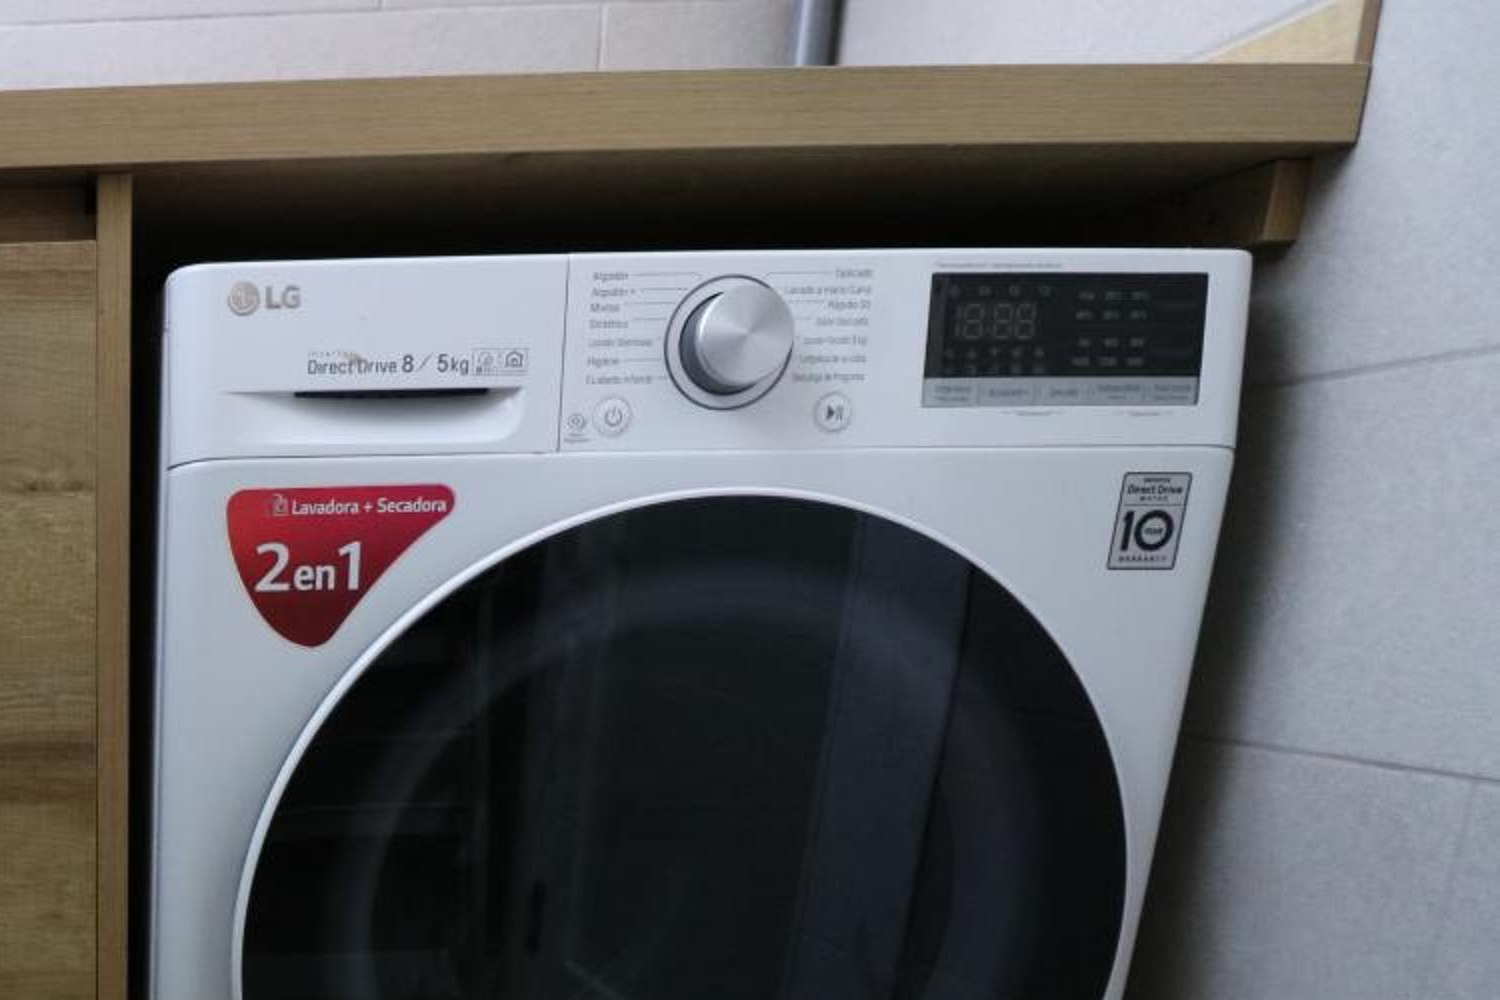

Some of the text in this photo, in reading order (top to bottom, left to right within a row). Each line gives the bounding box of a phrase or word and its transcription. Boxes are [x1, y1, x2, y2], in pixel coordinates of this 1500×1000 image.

[264, 285, 302, 309] LG
[307, 358, 355, 376] Direct
[356, 357, 397, 375] Drive
[401, 353, 414, 373] 8
[291, 497, 447, 515] Lavadora + Secadora
[1120, 509, 1175, 552] 10
